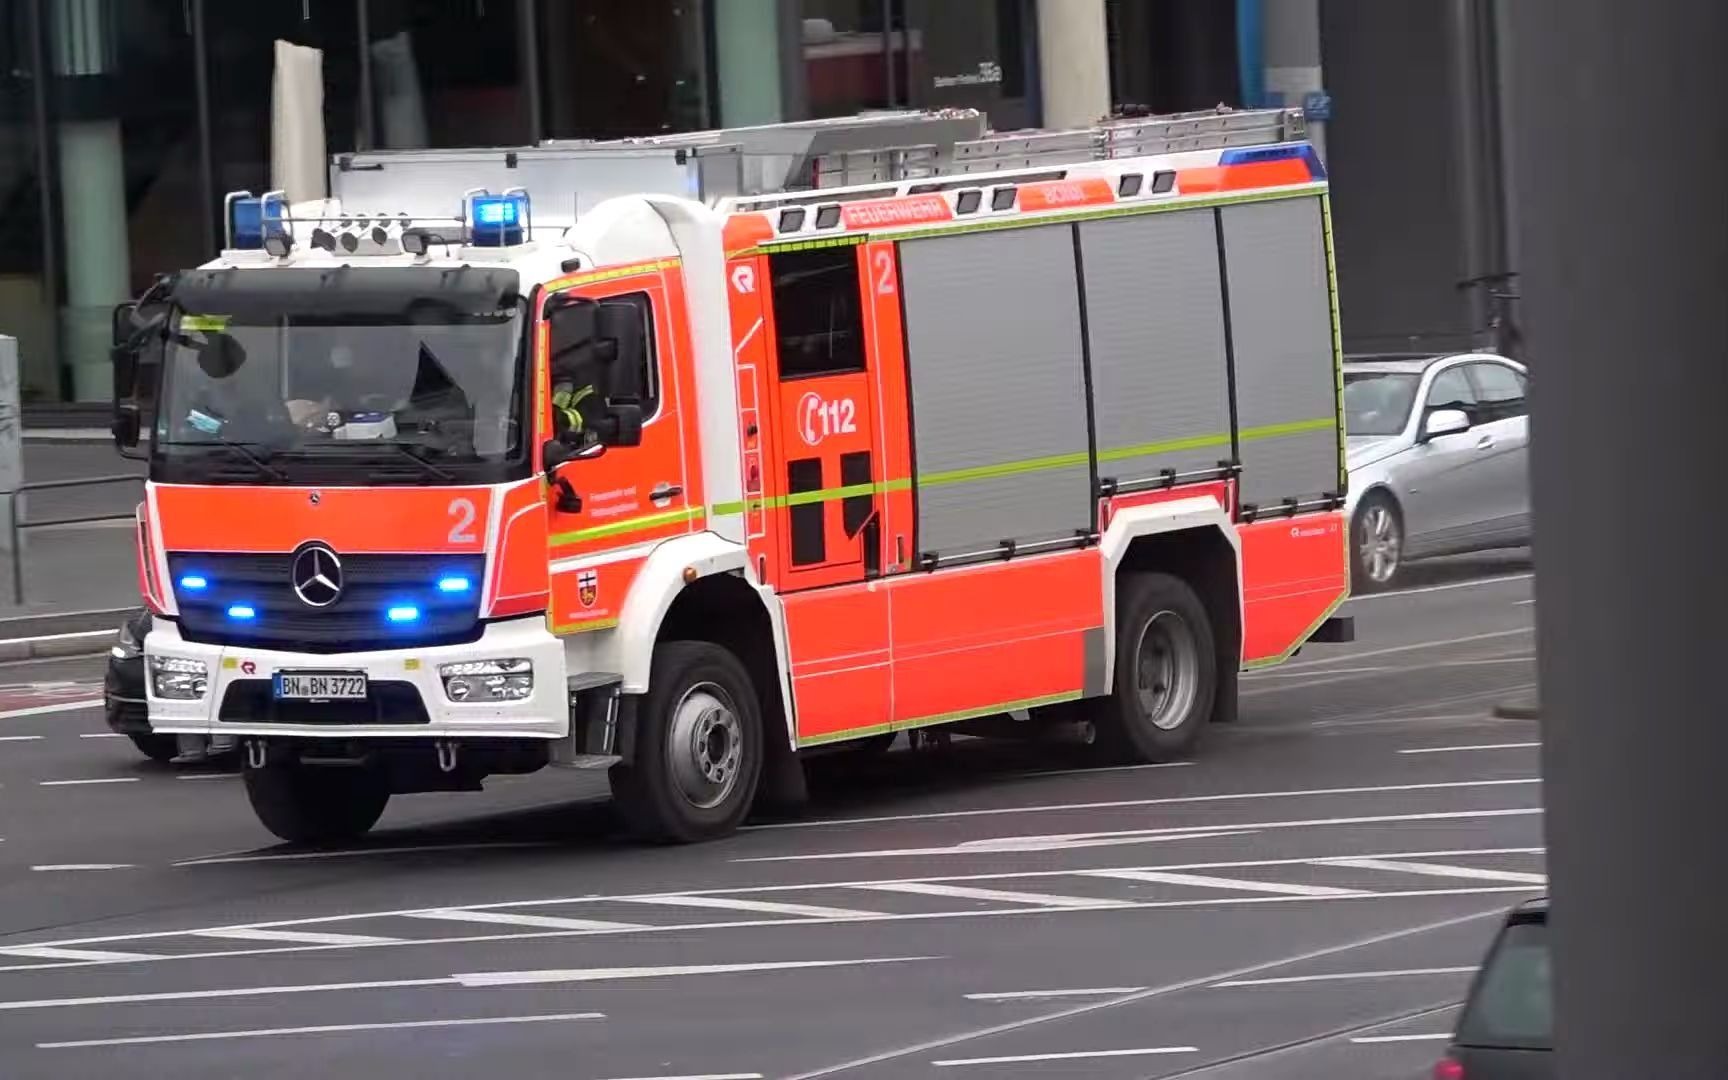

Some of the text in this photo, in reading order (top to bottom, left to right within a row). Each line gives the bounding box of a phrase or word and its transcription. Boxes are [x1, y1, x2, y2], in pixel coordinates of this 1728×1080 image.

[847, 201, 945, 226] FEUERWEHR
[876, 250, 894, 293] 2
[817, 398, 856, 435] 112
[448, 498, 475, 543] 2
[283, 678, 364, 694] BN BN 3722
